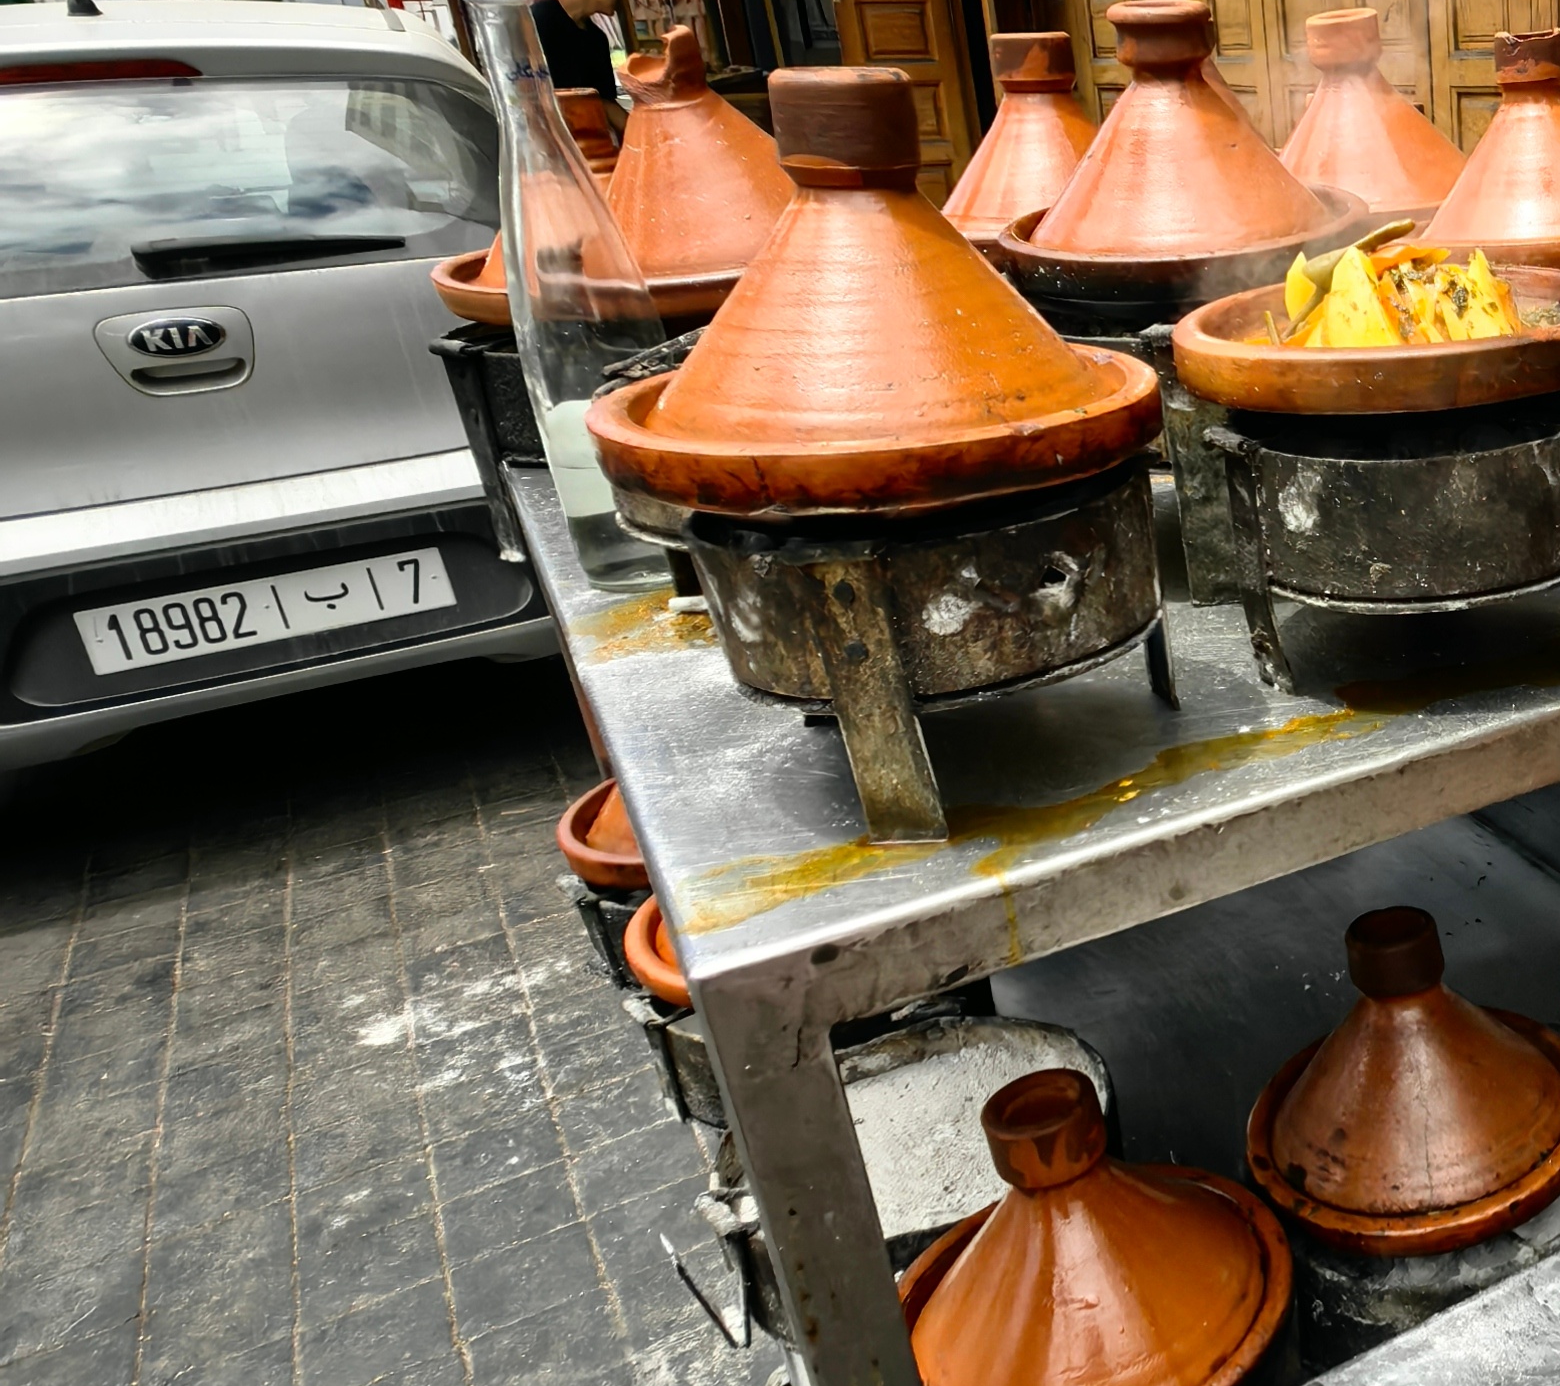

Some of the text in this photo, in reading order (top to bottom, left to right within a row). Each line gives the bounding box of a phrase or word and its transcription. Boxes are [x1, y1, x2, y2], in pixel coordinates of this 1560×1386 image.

[141, 325, 213, 351] KIA
[107, 558, 420, 660] 18982 ب 7
